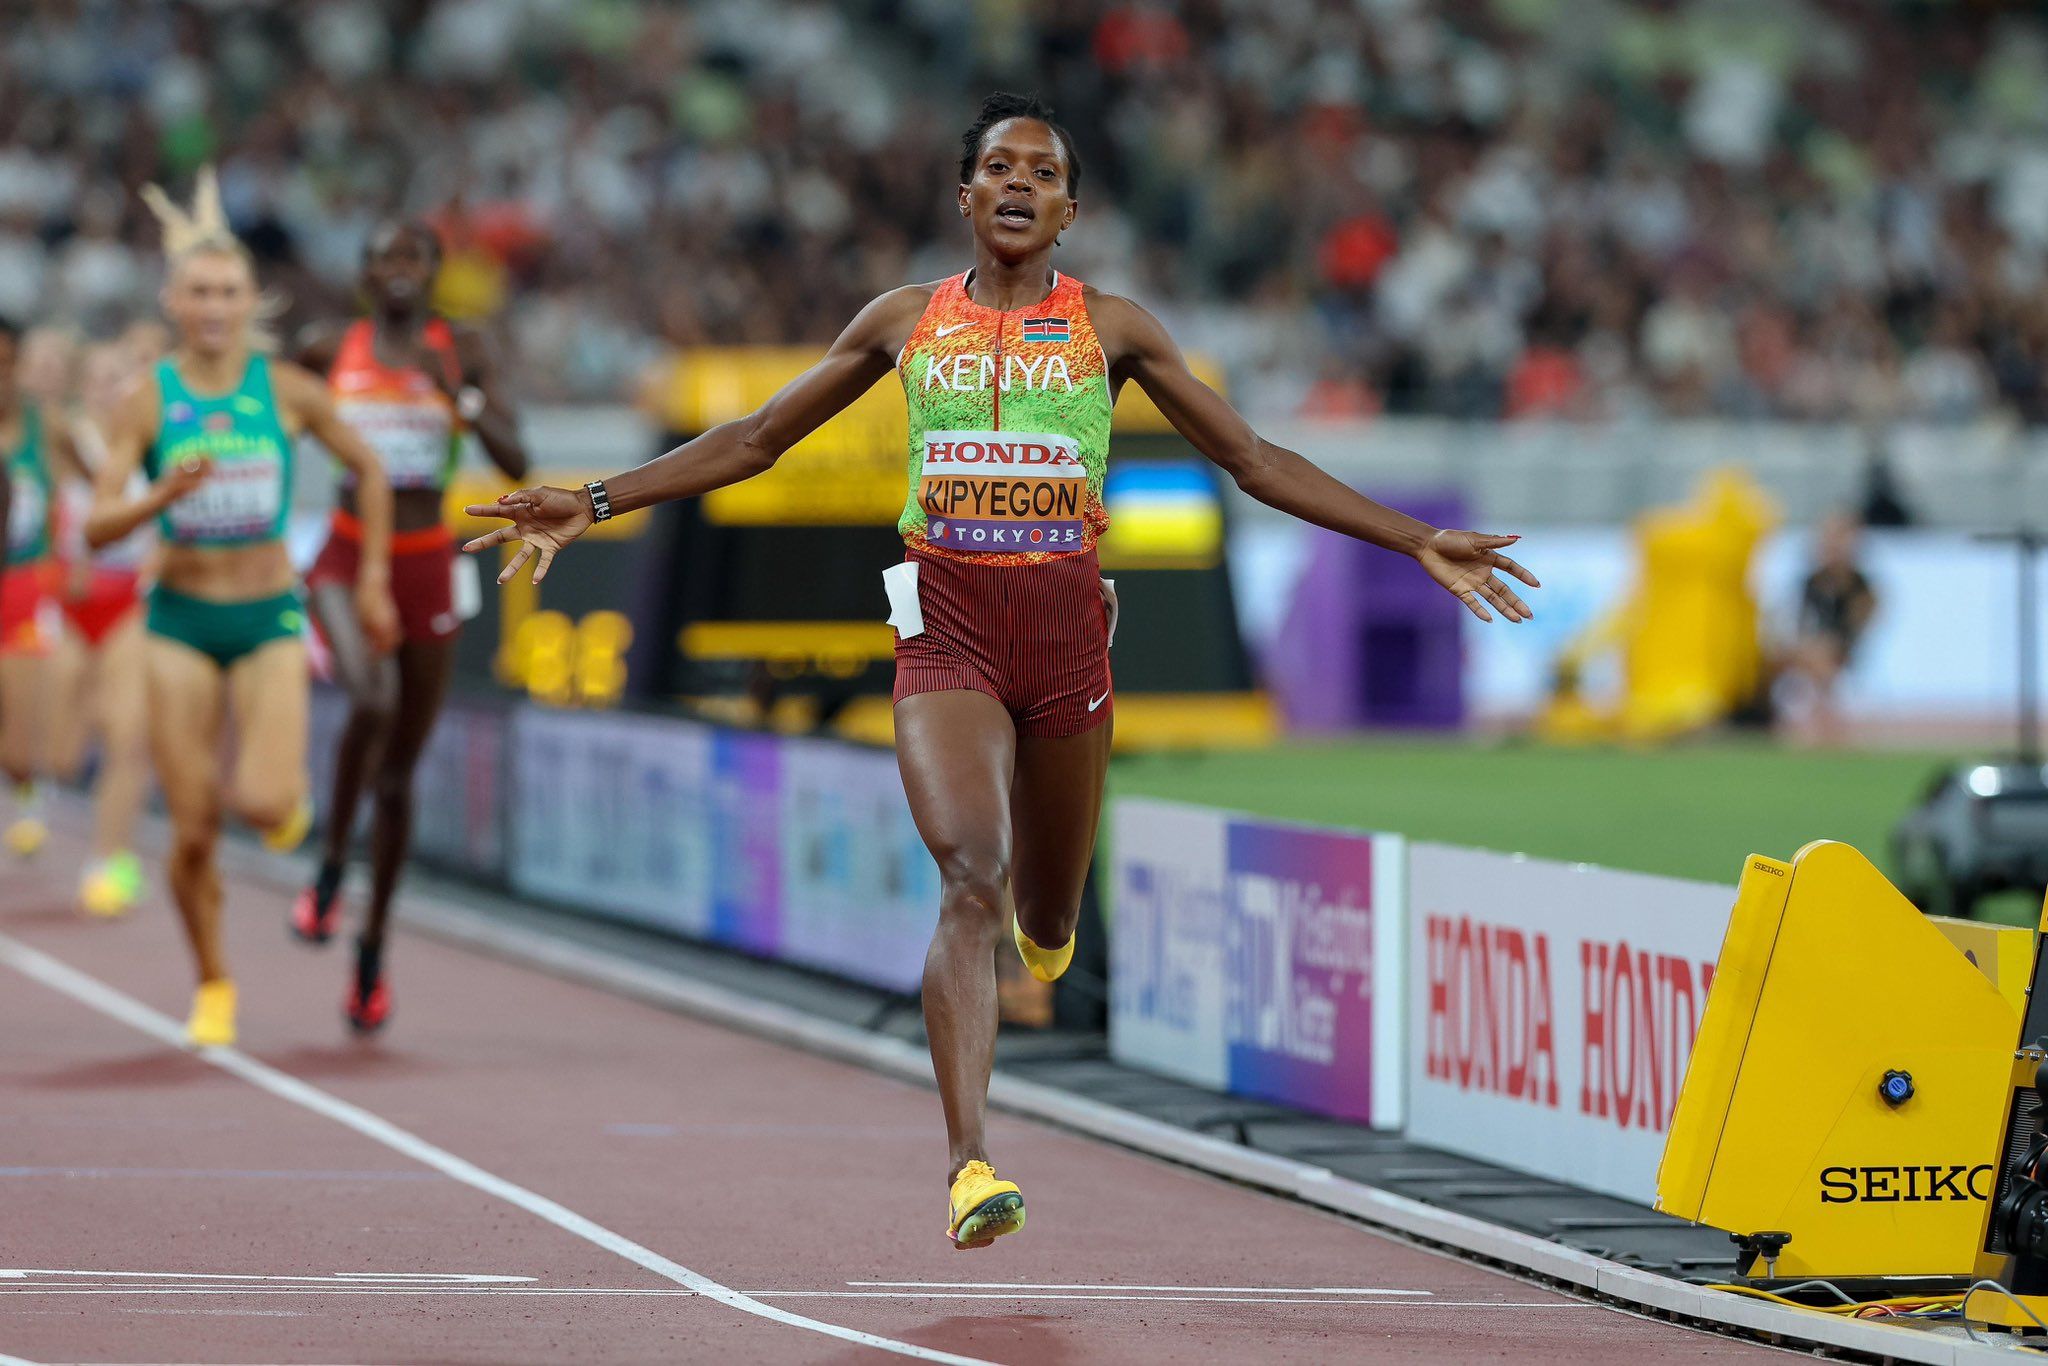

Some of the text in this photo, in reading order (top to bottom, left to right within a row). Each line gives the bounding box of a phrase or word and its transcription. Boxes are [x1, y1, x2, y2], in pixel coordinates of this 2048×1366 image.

[925, 354, 1074, 392] KENYA
[926, 442, 1079, 466] HONDA
[925, 480, 1078, 517] KIPYEGON
[1754, 862, 1784, 877] SEIKO
[1426, 912, 1560, 1111] HONDA
